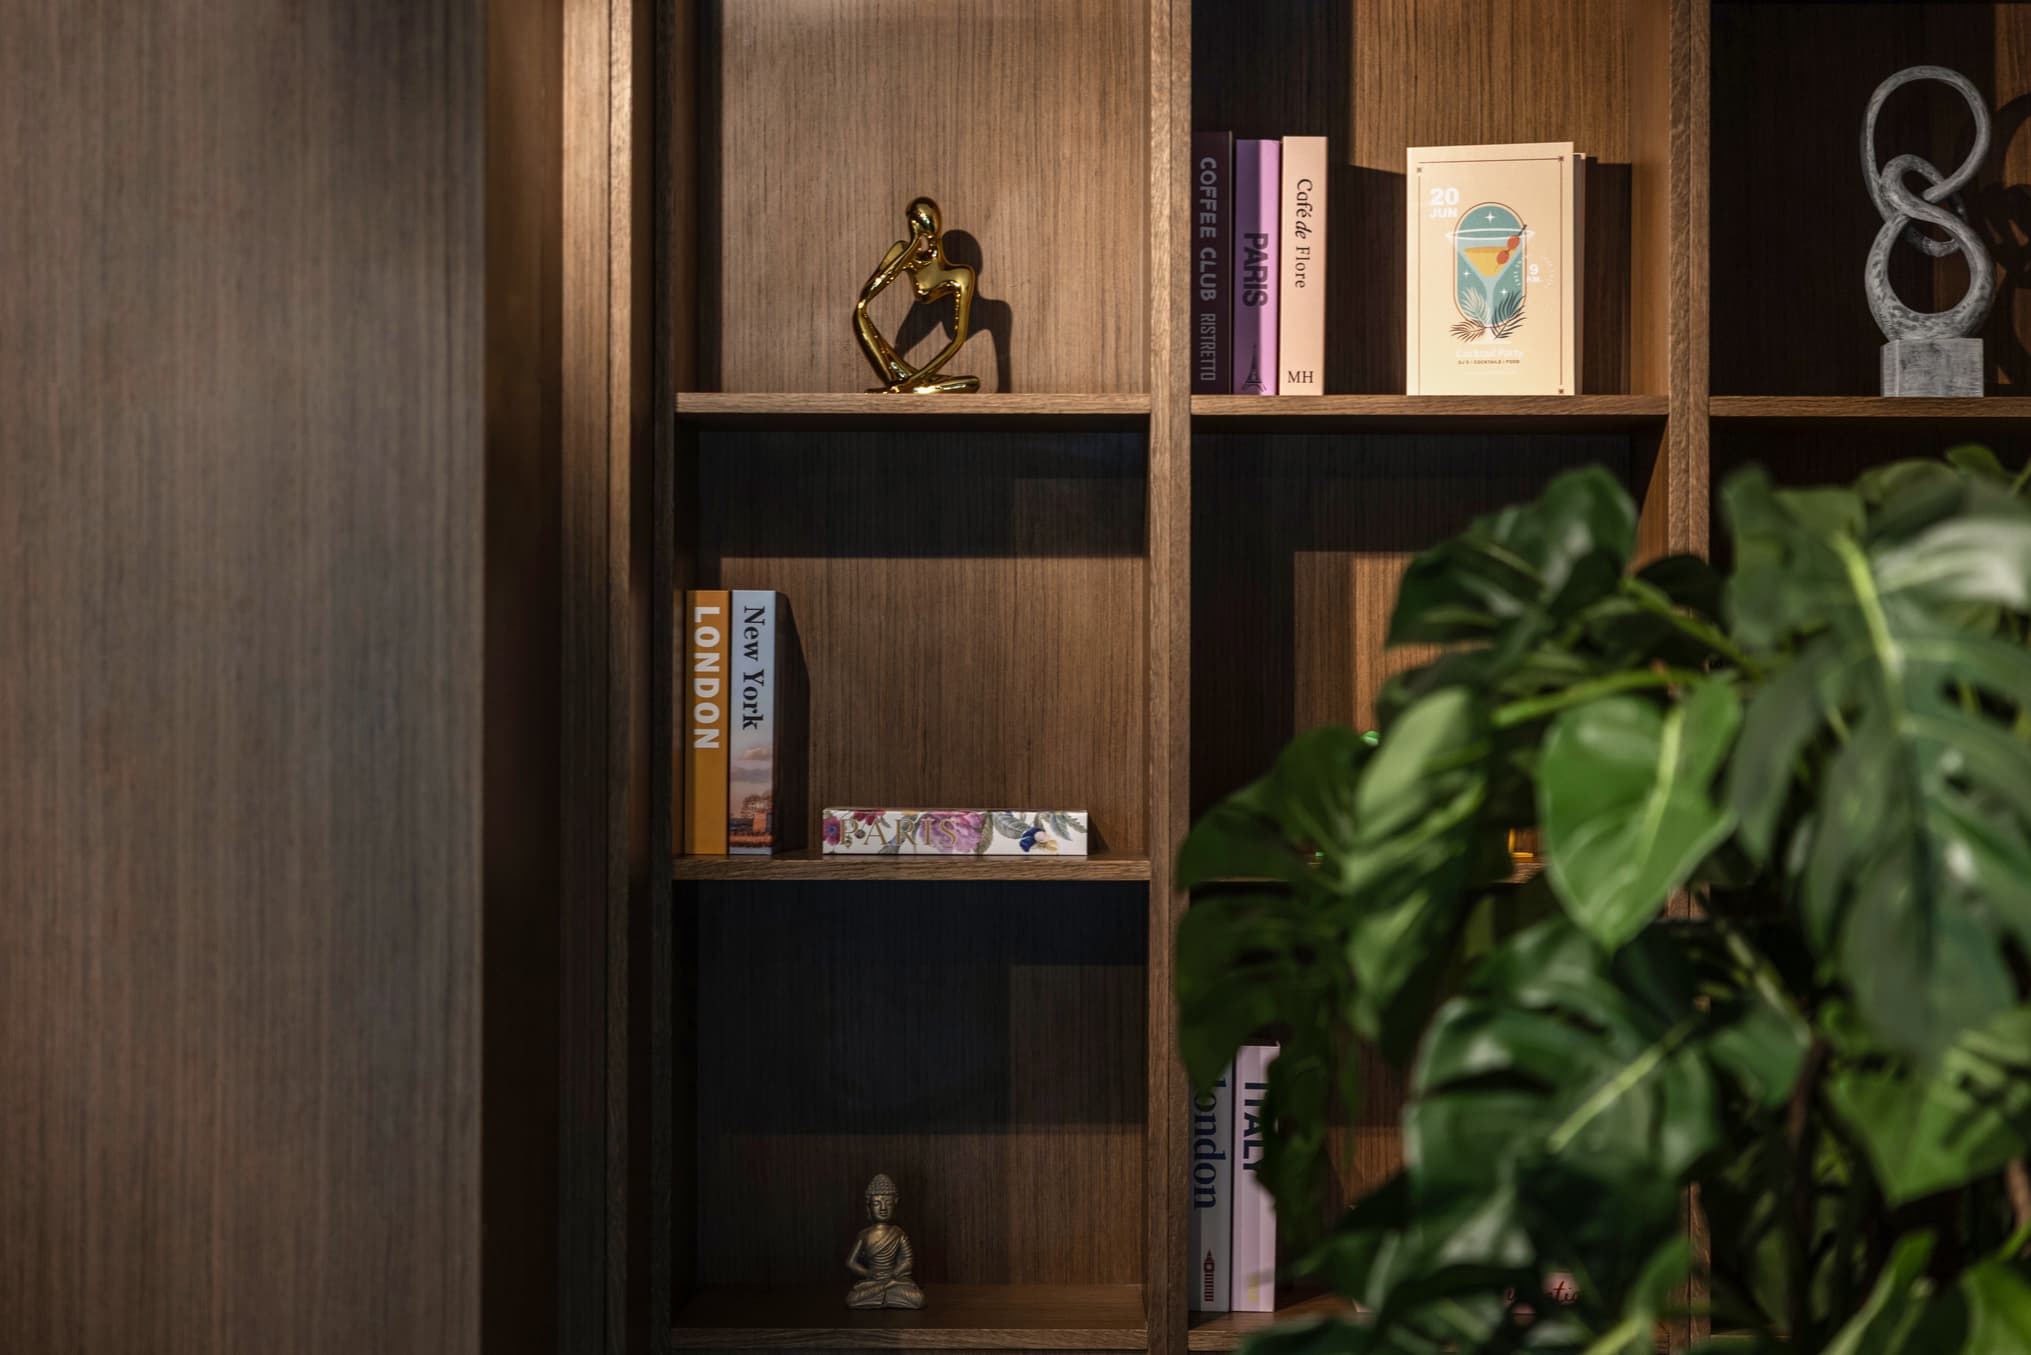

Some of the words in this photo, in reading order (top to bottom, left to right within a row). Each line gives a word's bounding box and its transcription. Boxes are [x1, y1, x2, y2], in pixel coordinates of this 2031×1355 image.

[1200, 156, 1217, 238] COFFEE
[1295, 178, 1313, 218] Café
[1429, 187, 1460, 206] 20
[1429, 207, 1458, 219] JUN
[1294, 221, 1312, 239] de
[1200, 247, 1217, 302] CLUB
[1242, 233, 1269, 307] PARIS
[1294, 246, 1311, 288] Flore
[1529, 263, 1539, 275] 9
[1200, 313, 1217, 381] RISTRETTO
[1287, 370, 1314, 384] MH
[743, 606, 765, 662] New
[693, 606, 721, 749] LONDON
[742, 669, 765, 731] York
[839, 818, 957, 846] PARIS
